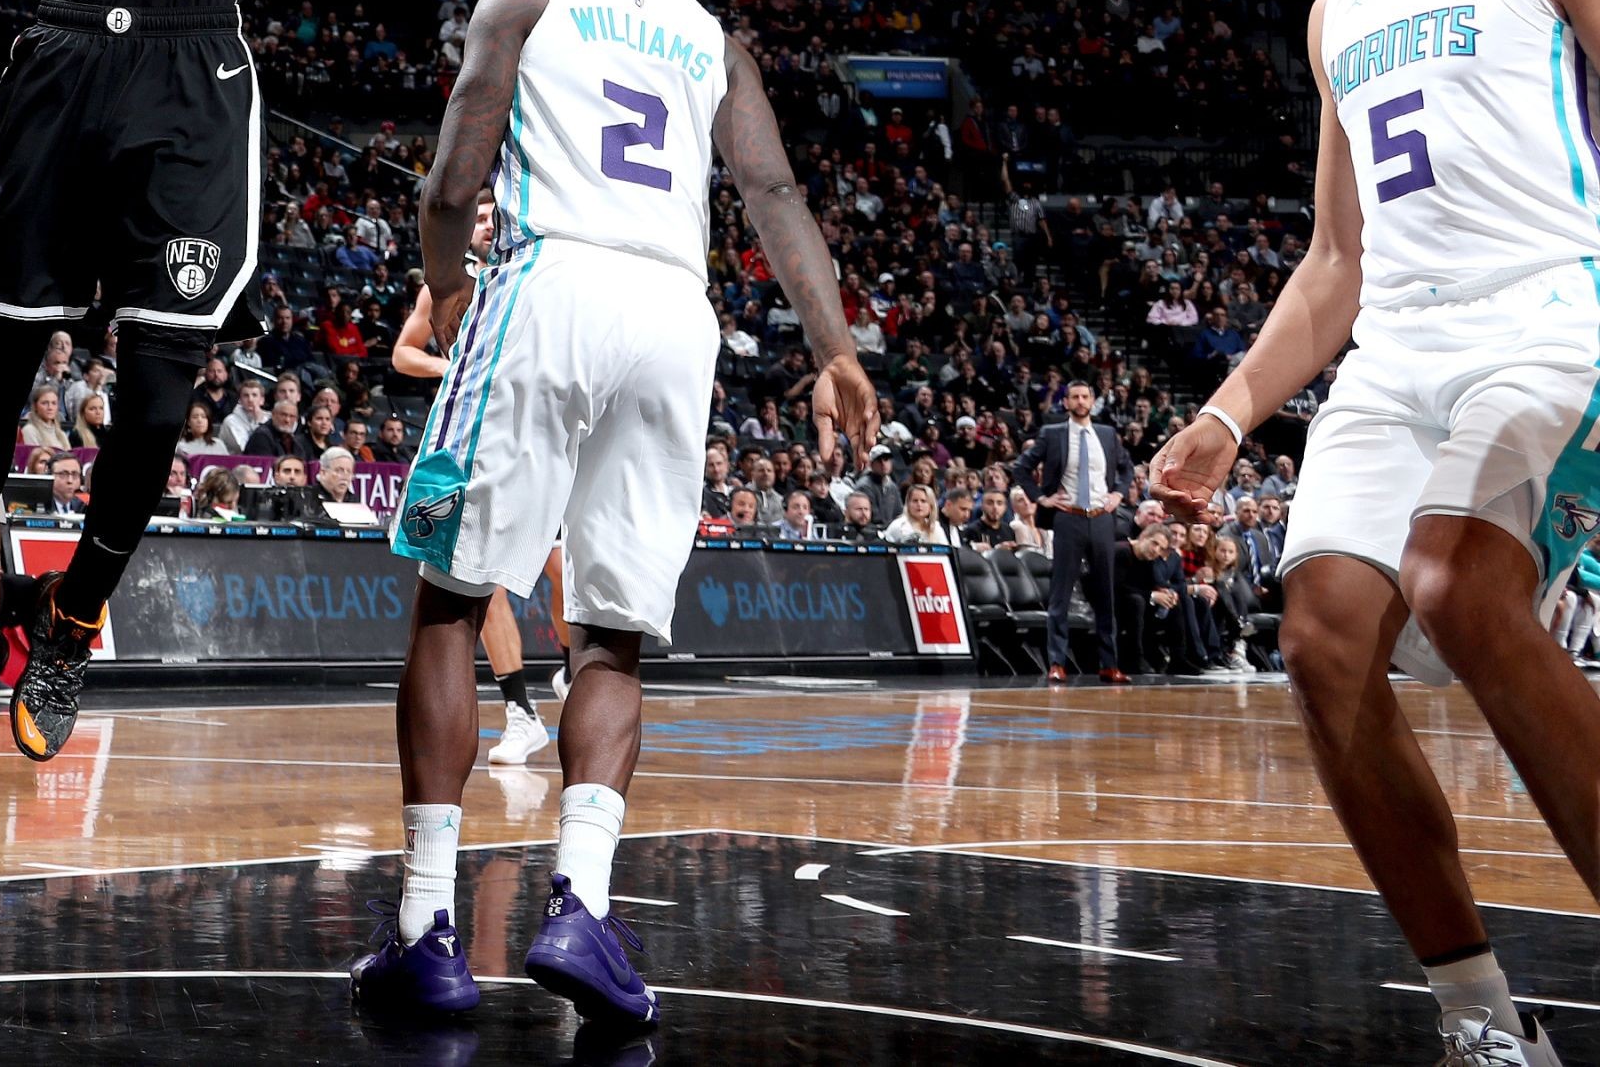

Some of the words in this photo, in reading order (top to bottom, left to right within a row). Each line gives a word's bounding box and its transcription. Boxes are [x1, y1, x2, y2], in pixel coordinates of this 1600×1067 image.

[569, 6, 714, 82] WILLIAMS
[1329, 4, 1484, 104] HORNETS
[601, 78, 670, 193] 2
[1368, 88, 1437, 205] 5
[169, 240, 218, 270] NETS
[222, 573, 405, 622] BARCLAYS
[733, 580, 877, 623] BARCLAYS
[913, 586, 952, 614] infor
